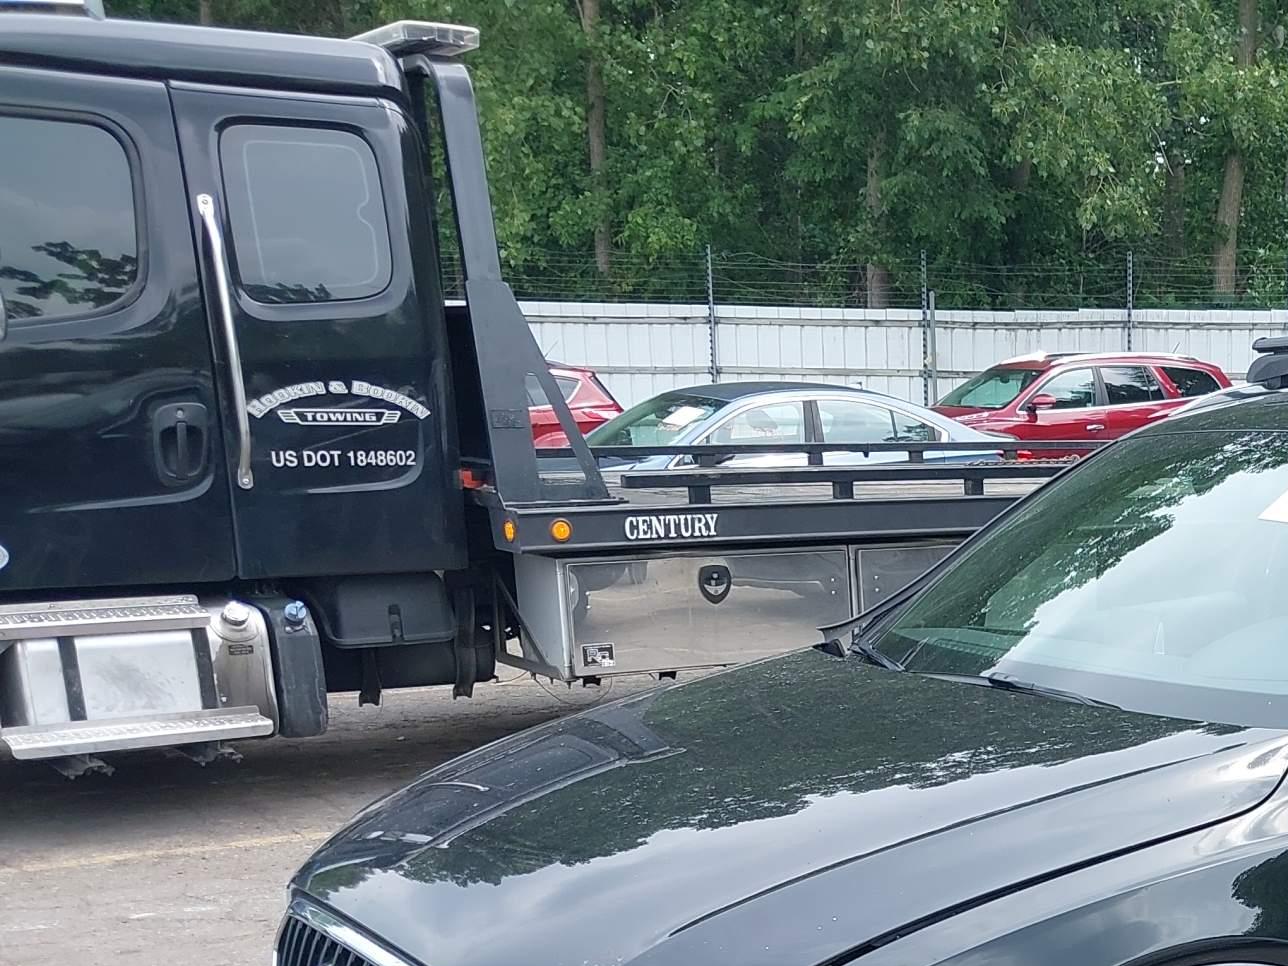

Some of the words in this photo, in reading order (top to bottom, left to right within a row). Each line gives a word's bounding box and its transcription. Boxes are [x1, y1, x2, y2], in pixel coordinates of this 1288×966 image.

[303, 412, 377, 422] TOWING
[271, 450, 298, 467] US
[303, 450, 341, 467] DOT
[347, 450, 416, 467] 1848602
[624, 513, 719, 540] CENTURY
